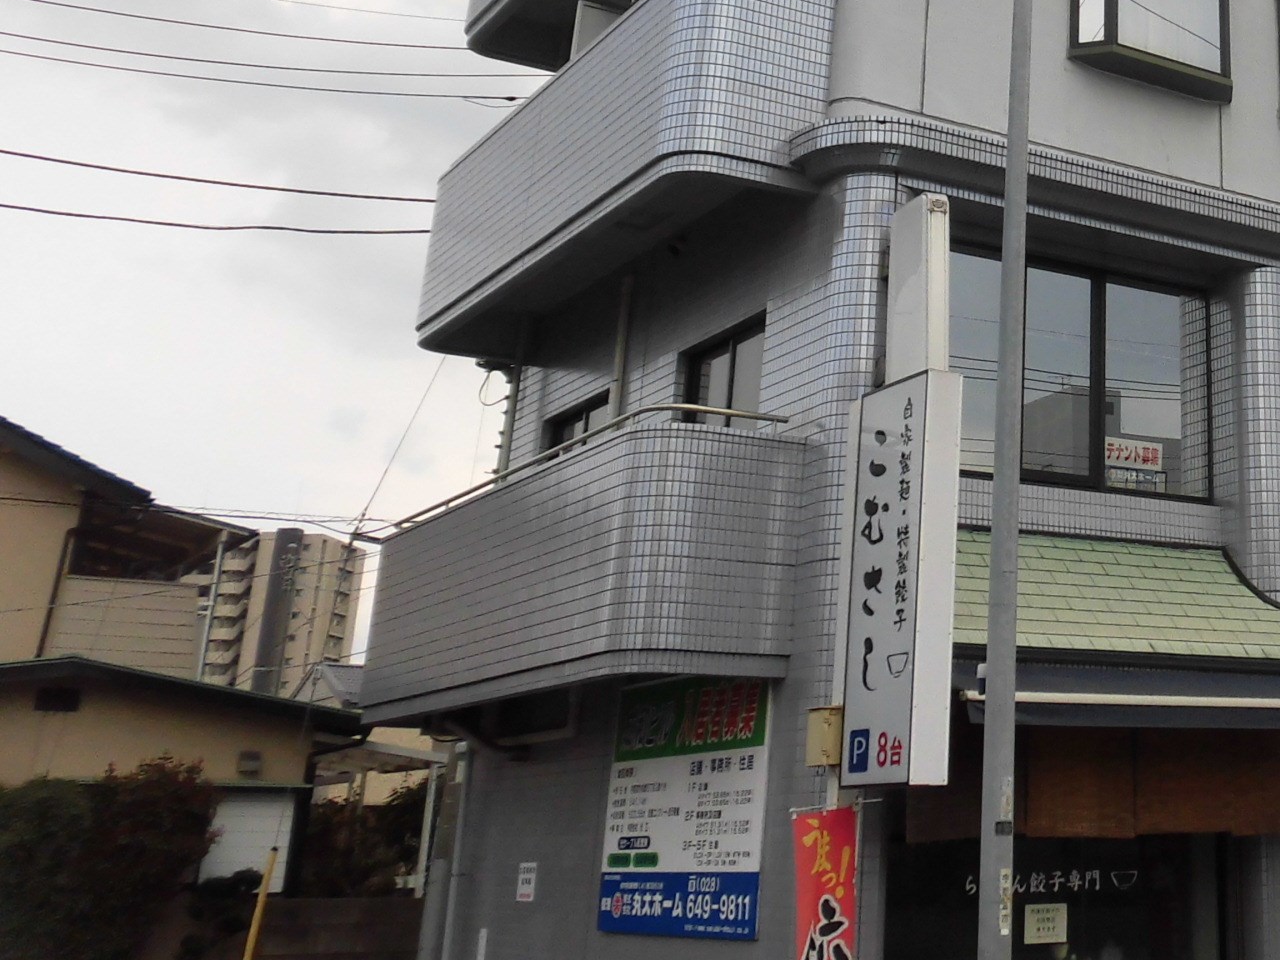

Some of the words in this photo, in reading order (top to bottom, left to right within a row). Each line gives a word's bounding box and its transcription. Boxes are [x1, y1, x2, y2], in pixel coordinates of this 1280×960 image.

[1106, 442, 1160, 466] テナント募集
[853, 737, 866, 764] P
[877, 731, 903, 769] 8台
[965, 869, 1101, 895] らん餃子専門
[686, 893, 750, 921] 649-9811
